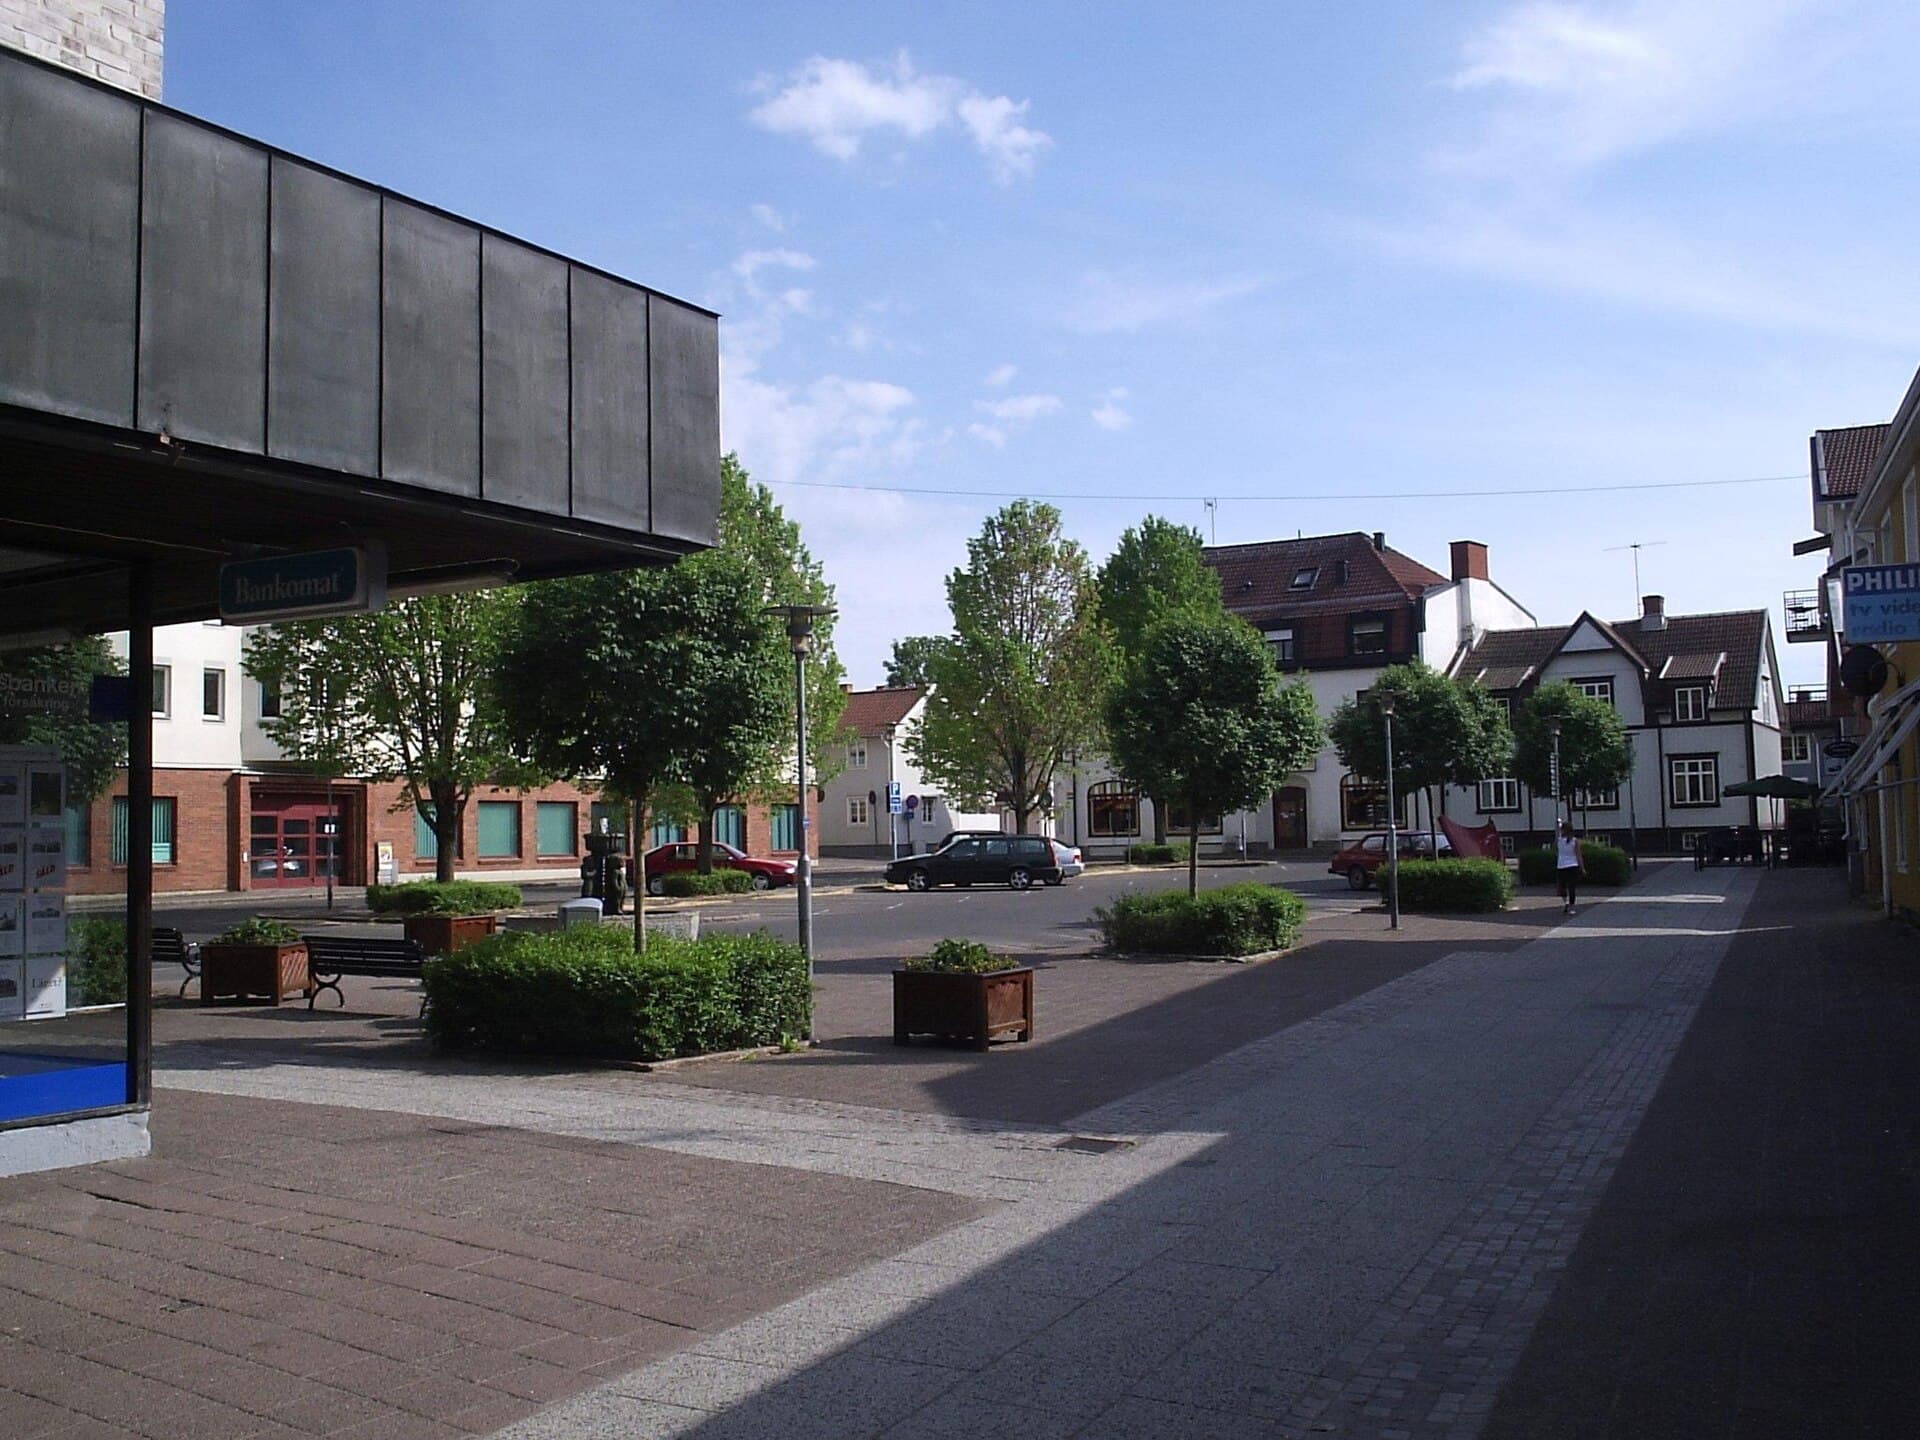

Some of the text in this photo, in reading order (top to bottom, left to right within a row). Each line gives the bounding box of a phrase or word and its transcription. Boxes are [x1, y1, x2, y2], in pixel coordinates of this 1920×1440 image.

[234, 570, 340, 604] Bankomat
[1846, 568, 1920, 593] PHILI
[1849, 603, 1872, 616] tv
